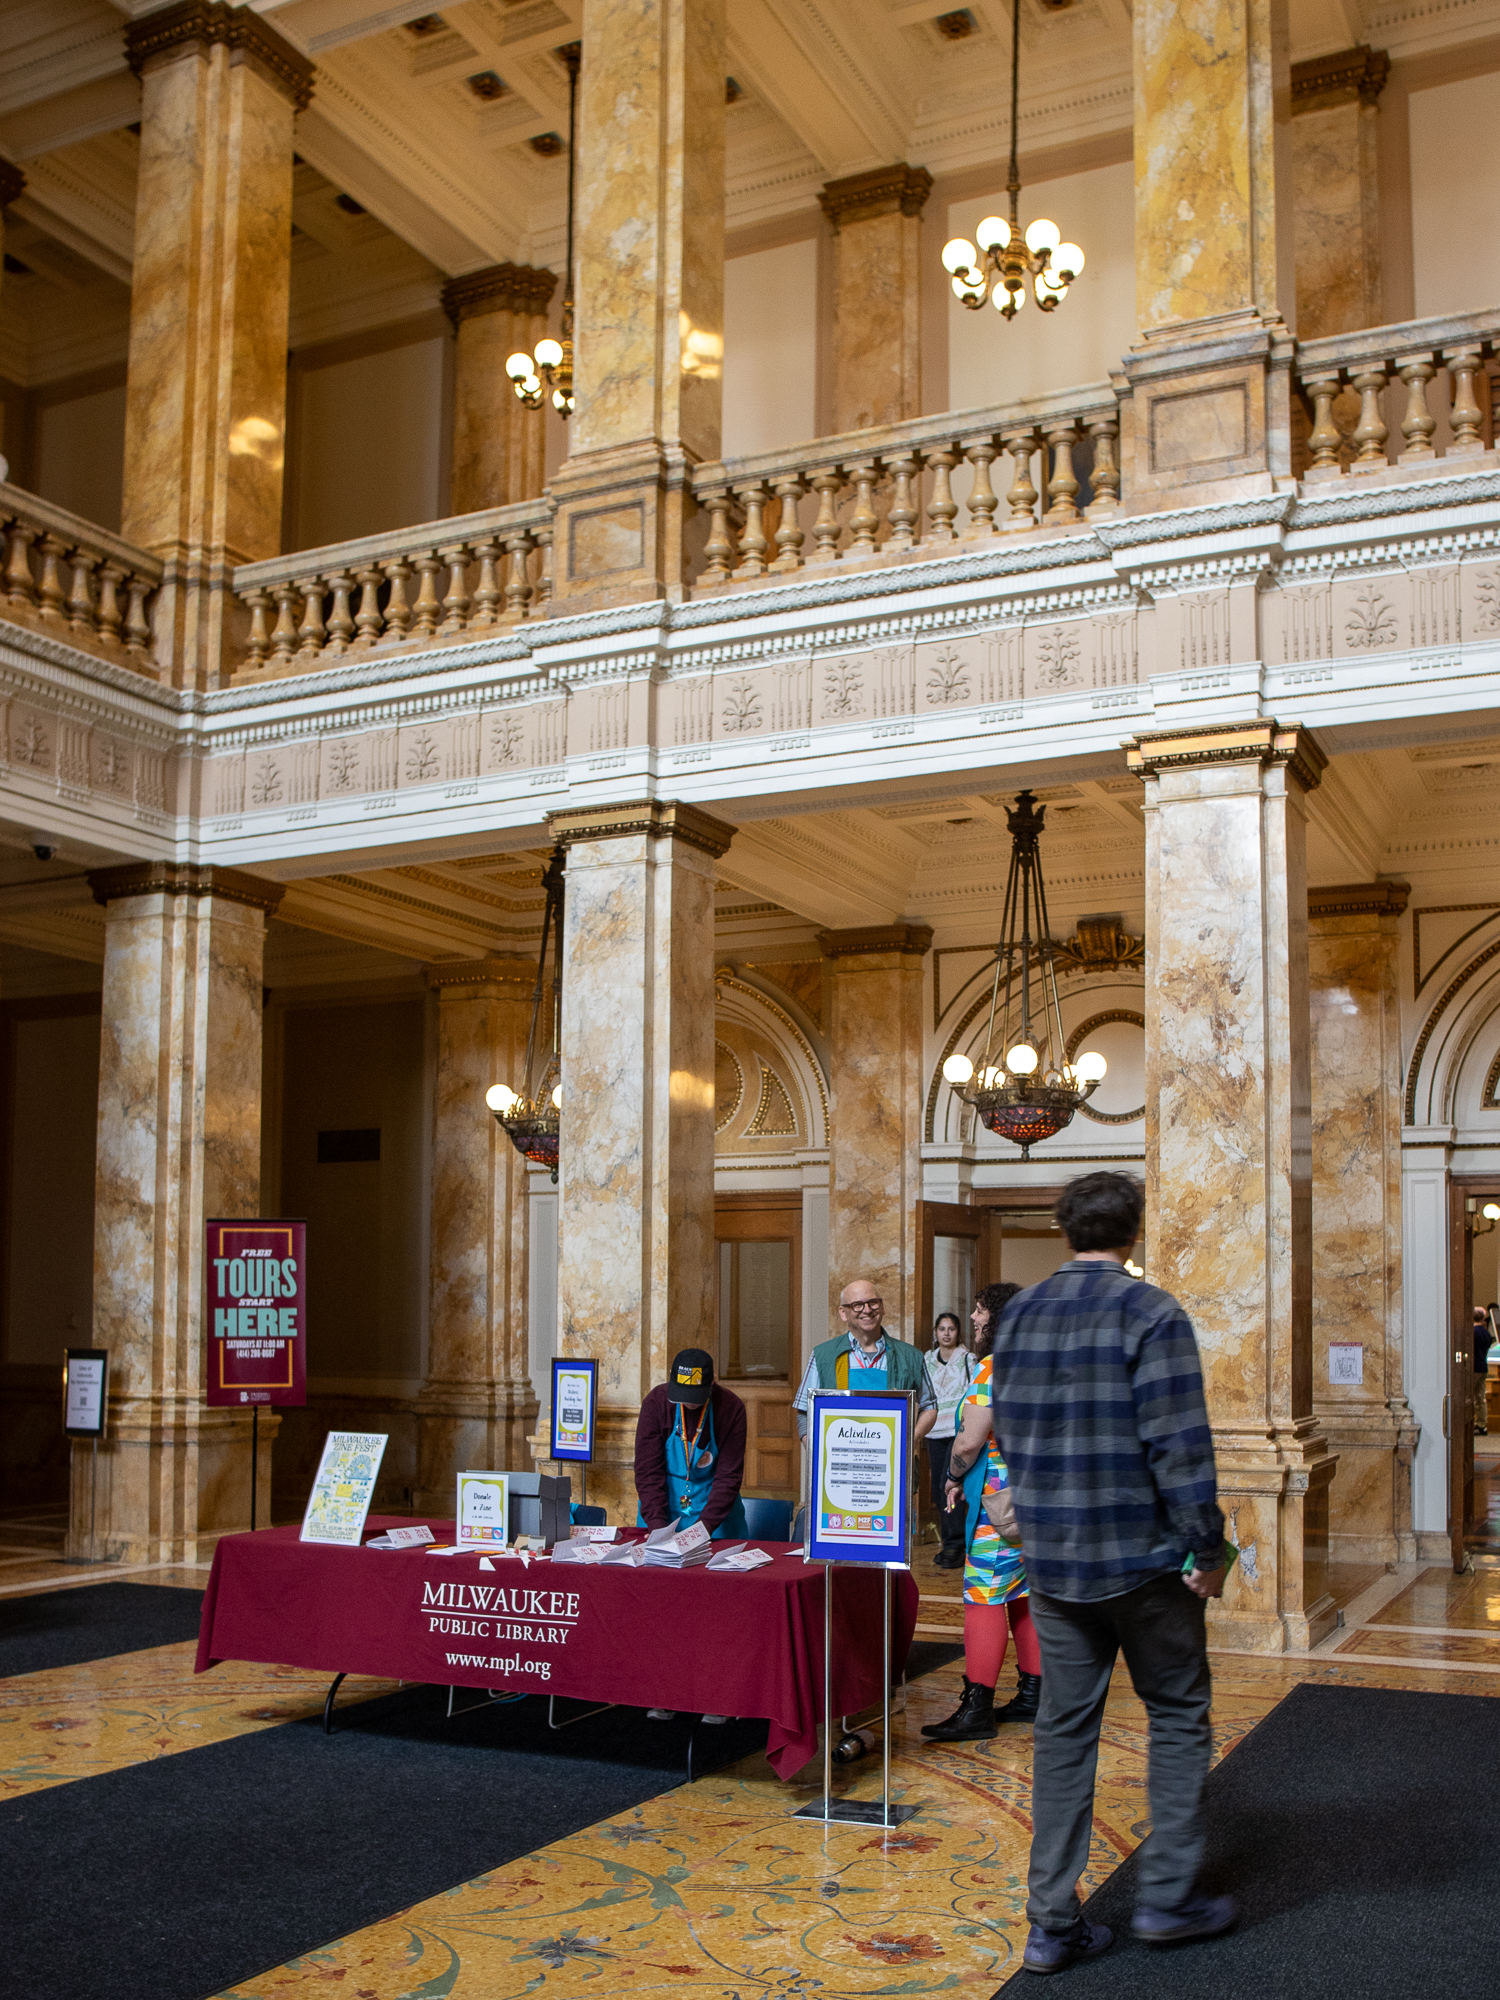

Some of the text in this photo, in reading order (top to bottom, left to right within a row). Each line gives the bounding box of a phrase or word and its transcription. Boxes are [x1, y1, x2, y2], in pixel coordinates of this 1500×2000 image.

[241, 1248, 273, 1257] FREE
[213, 1258, 298, 1298] TOURS
[238, 1298, 274, 1307] START
[214, 1307, 298, 1338] HERE
[226, 1339, 285, 1349] SATURDAYS AT 11:00 AM
[236, 1349, 250, 1358] (414)
[838, 1427, 881, 1439] Activities
[332, 1435, 383, 1445] MILWAUKEE
[333, 1443, 377, 1453] ZINE FEST
[473, 1492, 492, 1500] Donate
[479, 1503, 492, 1511] Zine
[421, 1582, 580, 1618] MILWAUKEE
[428, 1617, 570, 1644] PUBLIC LIBRARY
[445, 1652, 552, 1681] www.mpl.org
